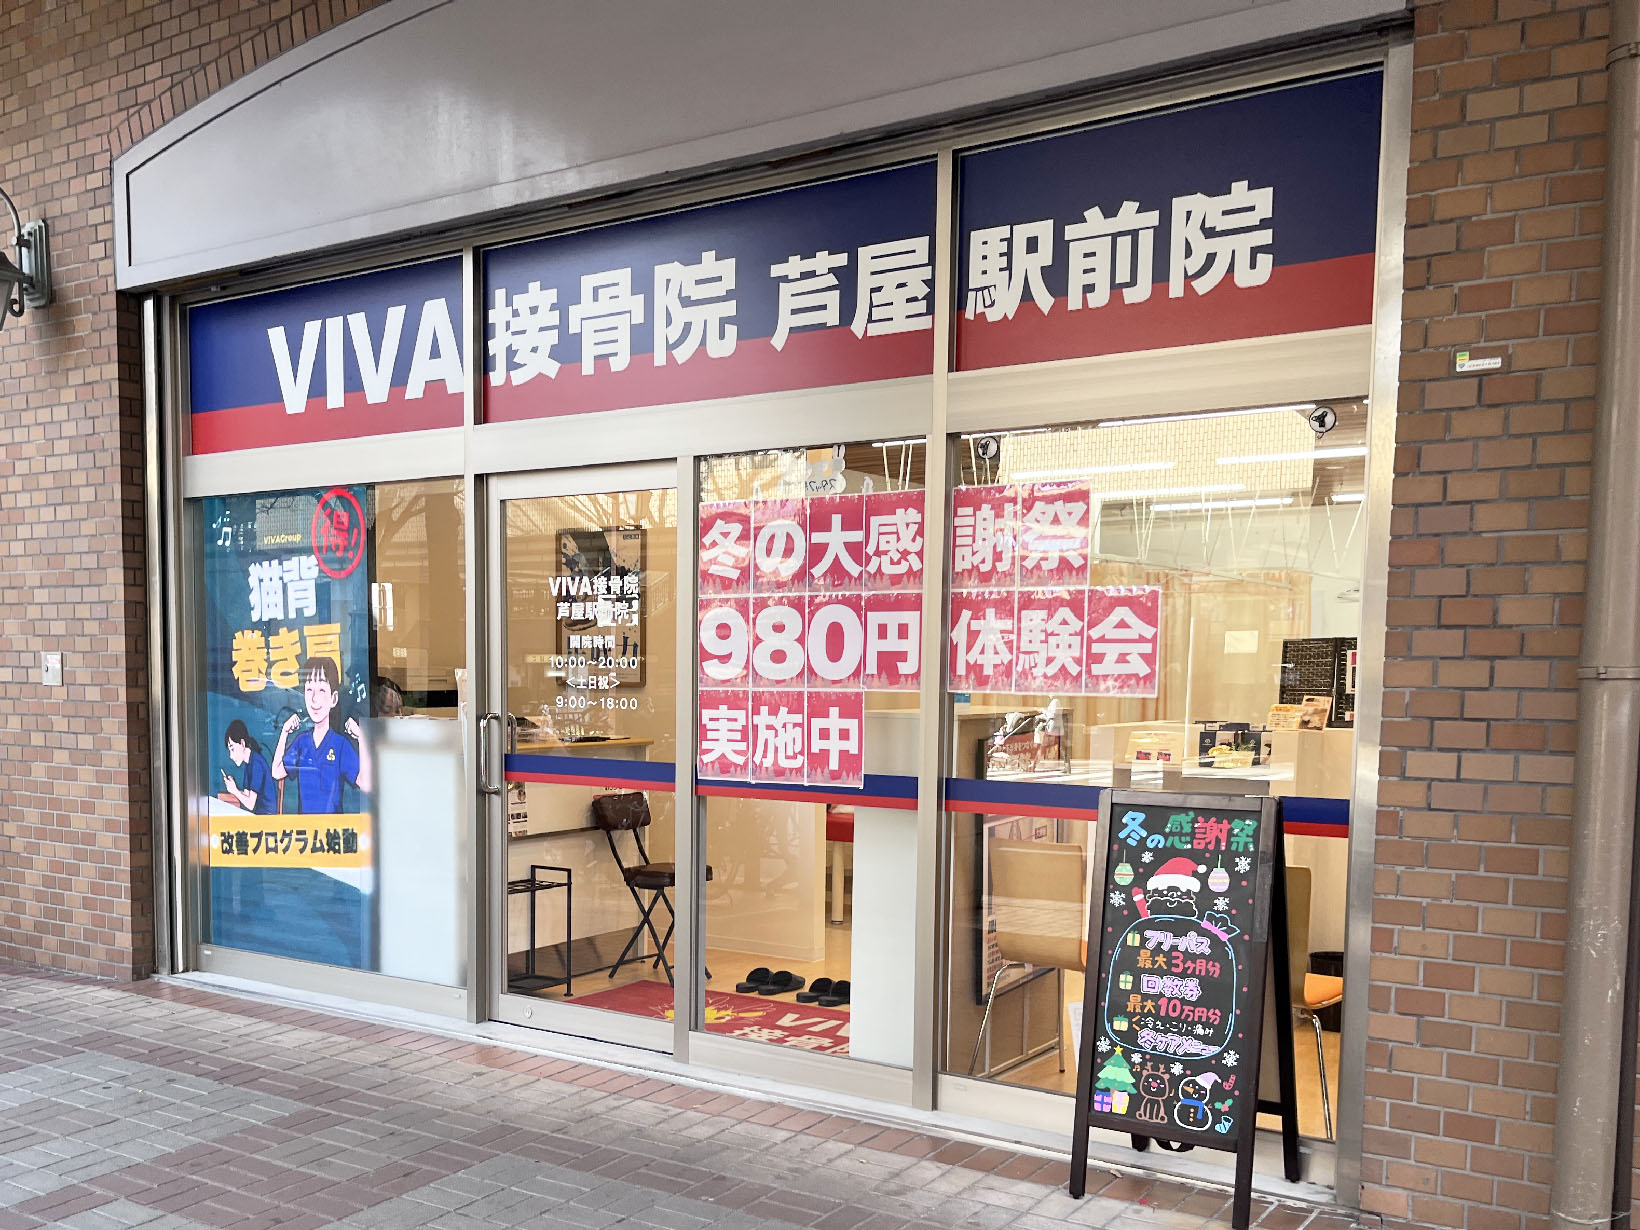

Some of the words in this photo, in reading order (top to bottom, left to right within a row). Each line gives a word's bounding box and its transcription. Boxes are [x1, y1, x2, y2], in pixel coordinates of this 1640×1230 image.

[248, 554, 320, 622] 猫背
[548, 572, 639, 597] VIVA接骨院
[700, 704, 859, 771] 実施中
[220, 827, 358, 855] 改善プログラム始動
[1118, 810, 1259, 853] 冬の感謝祭
[1144, 929, 1212, 955] フリーパス
[1140, 974, 1202, 1002] 回数券
